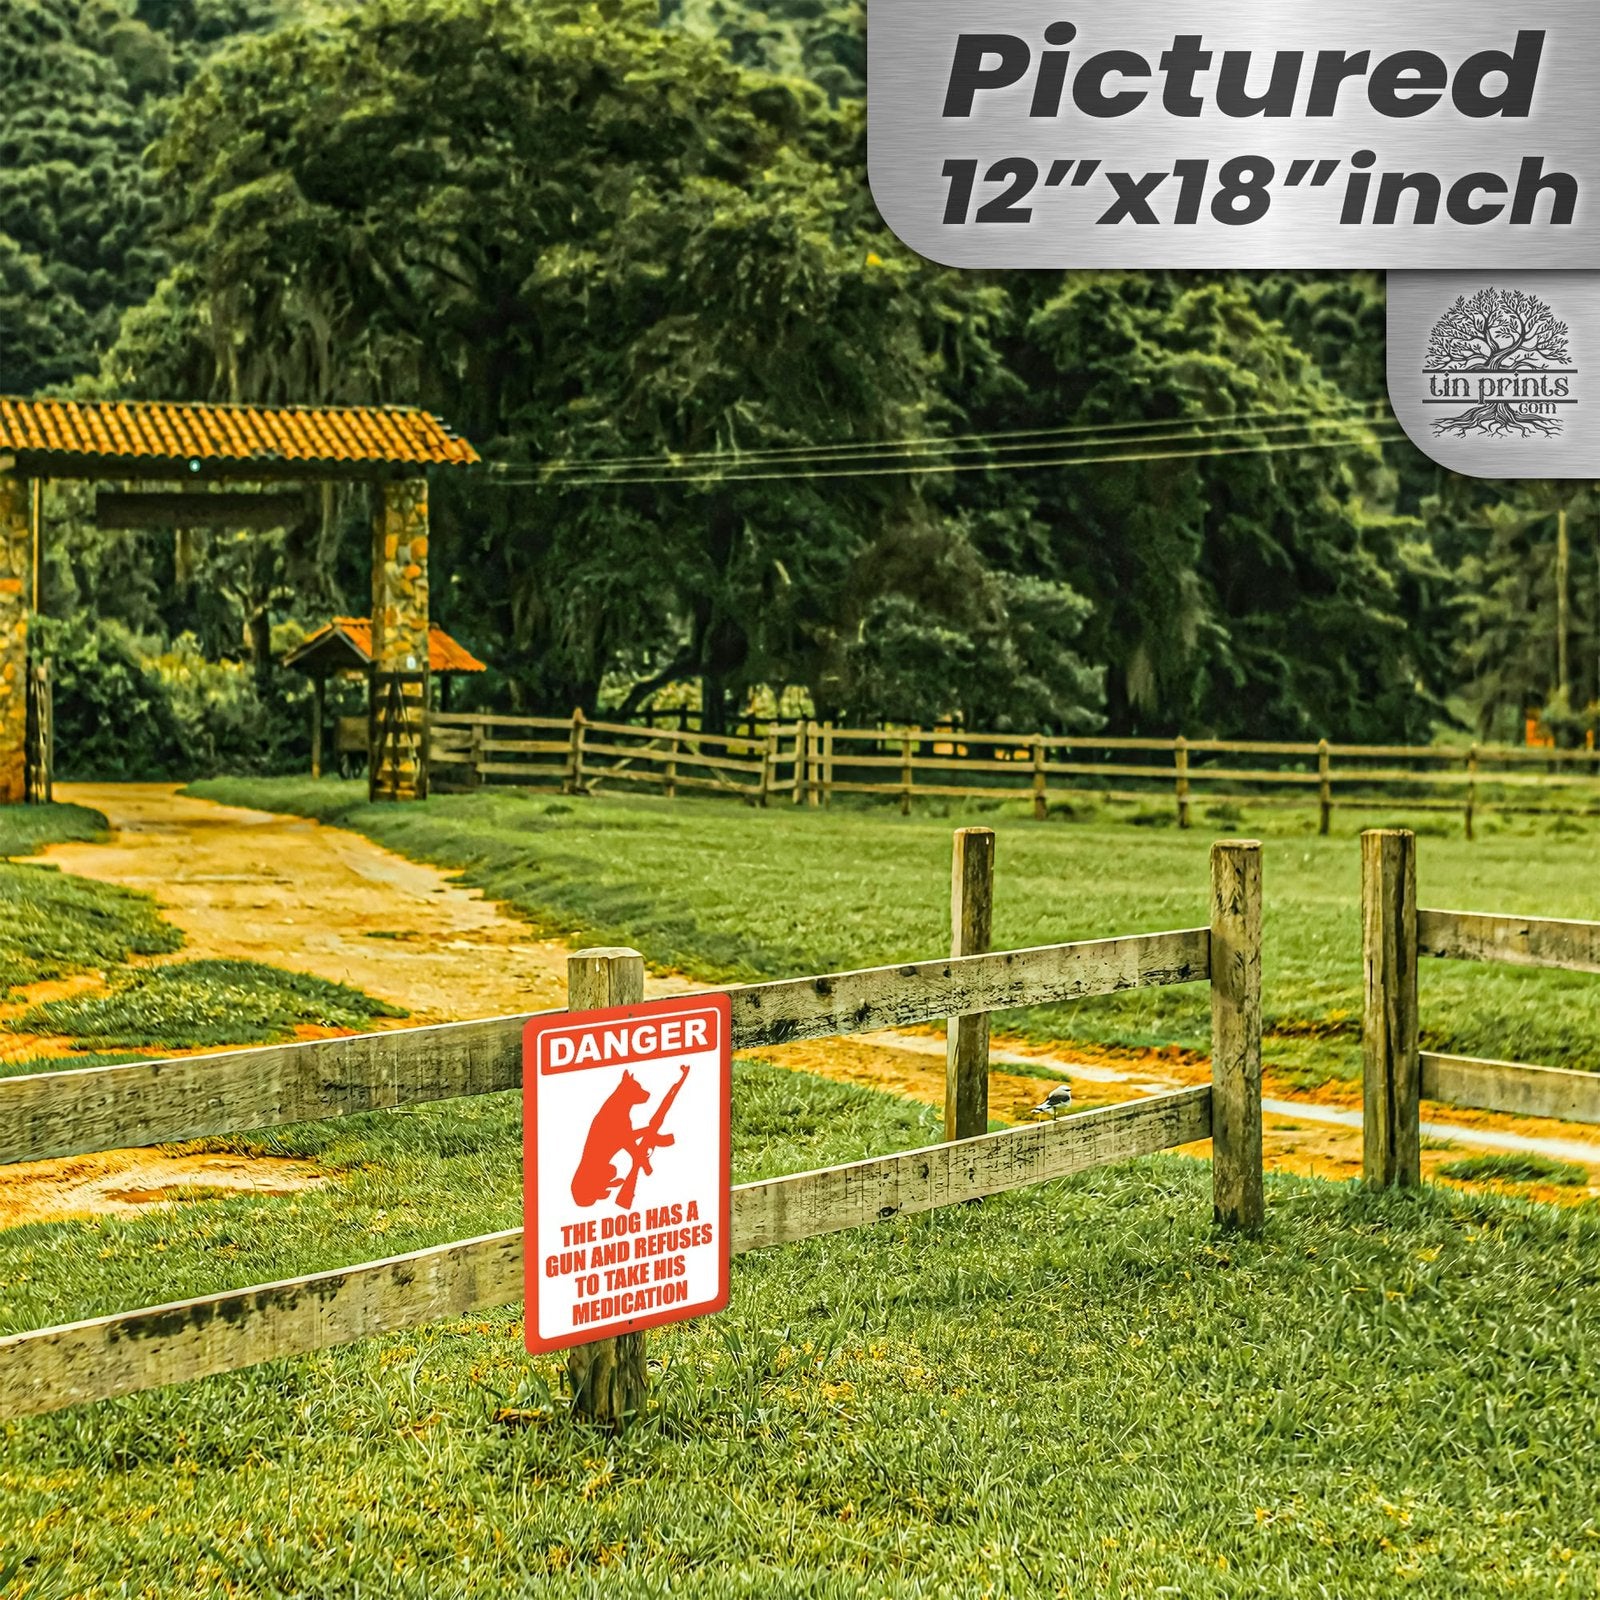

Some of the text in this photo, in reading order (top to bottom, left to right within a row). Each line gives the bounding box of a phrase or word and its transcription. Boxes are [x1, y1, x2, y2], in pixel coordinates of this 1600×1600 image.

[549, 1018, 708, 1068] DANGER
[561, 1200, 699, 1248] THE DOG HAS A
[545, 1223, 713, 1278] GUN AND REFUSES
[575, 1255, 686, 1298] TO TAKE HIS
[572, 1280, 688, 1326] MEDICATION
